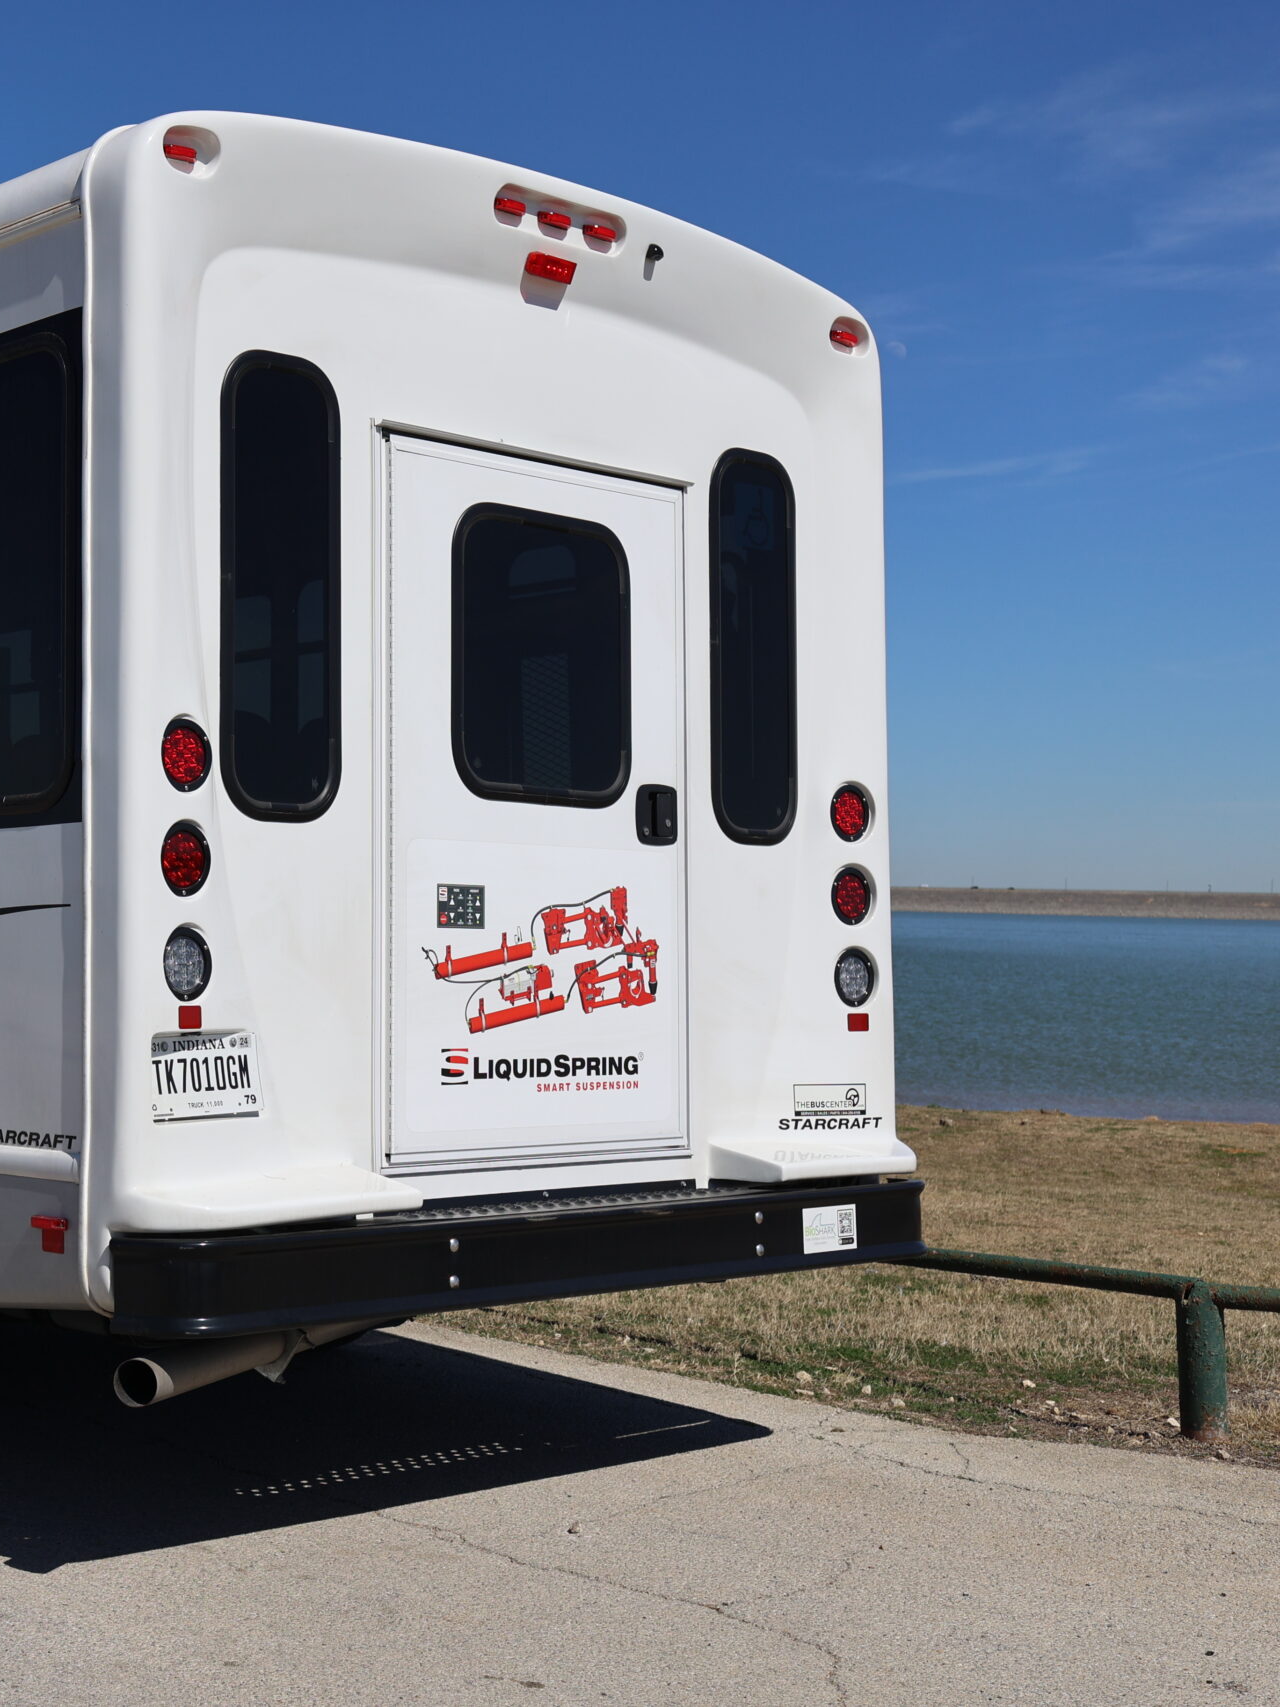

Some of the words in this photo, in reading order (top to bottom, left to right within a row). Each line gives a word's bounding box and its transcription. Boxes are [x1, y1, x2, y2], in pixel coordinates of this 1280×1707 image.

[172, 1038, 225, 1052] INDIANA
[536, 1081, 572, 1092] SMART
[575, 1080, 639, 1091] SUSPENSION
[244, 1095, 257, 1105] 79
[778, 1117, 882, 1130] STARCRAFT
